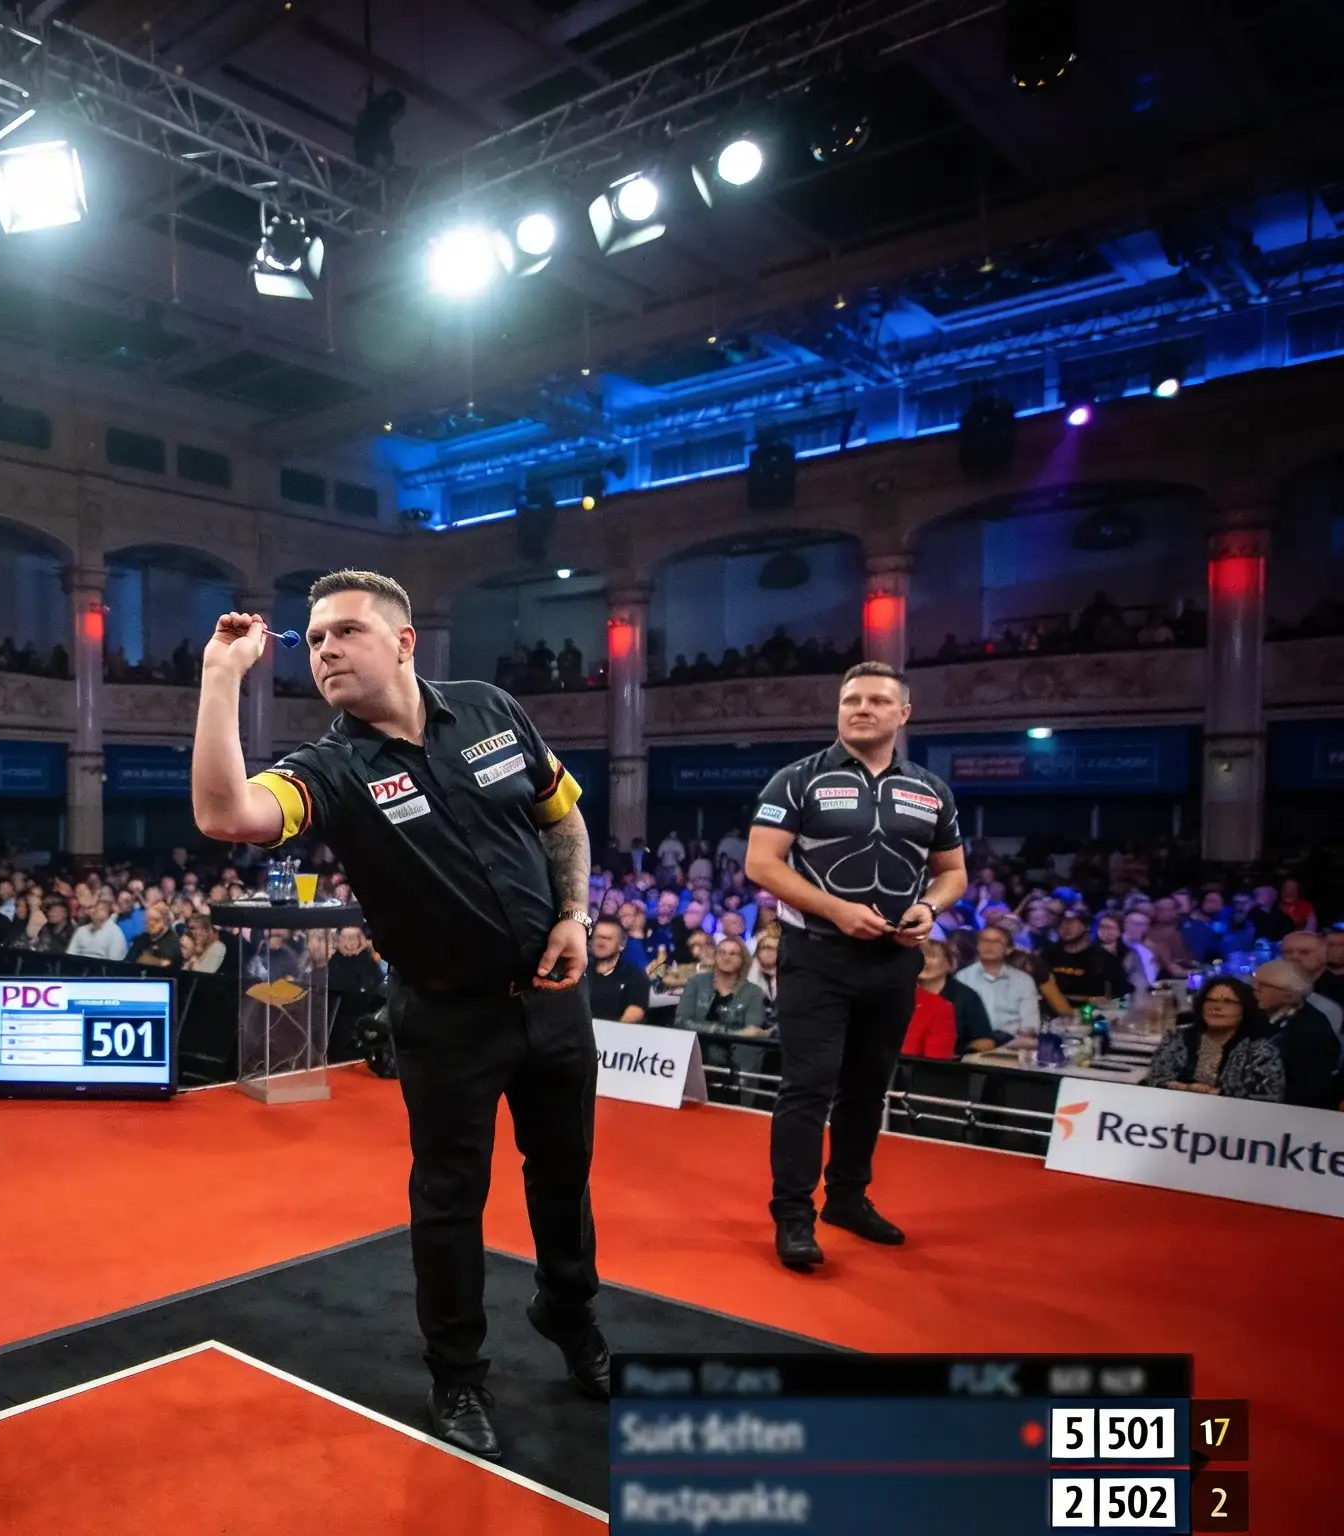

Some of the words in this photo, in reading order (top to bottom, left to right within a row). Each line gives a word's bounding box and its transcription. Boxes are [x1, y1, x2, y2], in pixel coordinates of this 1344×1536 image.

[371, 774, 415, 800] PDC
[2, 985, 62, 1008] PDC
[91, 1020, 153, 1058] 501
[1097, 1111, 1344, 1177] Restpunkte
